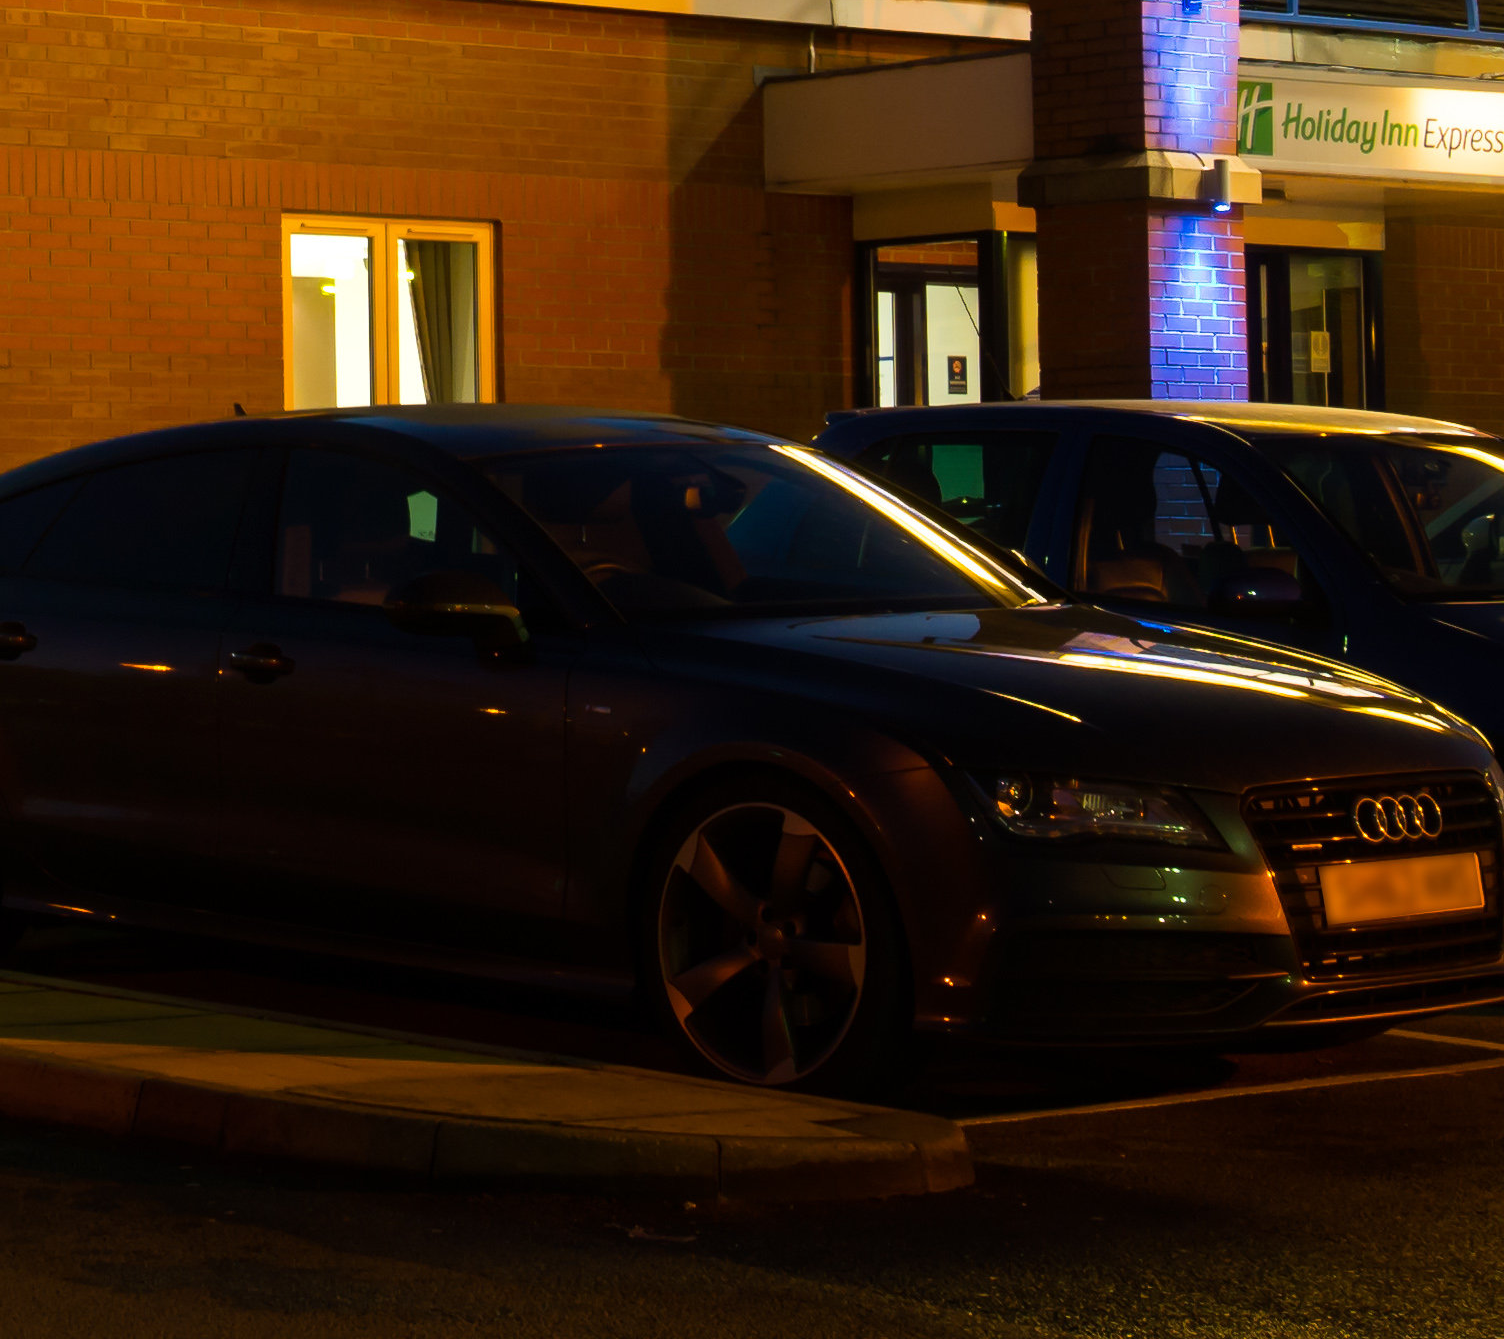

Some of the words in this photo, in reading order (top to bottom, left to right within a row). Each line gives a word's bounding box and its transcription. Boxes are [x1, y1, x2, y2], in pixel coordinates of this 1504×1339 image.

[1281, 102, 1377, 155] Holiday
[1380, 109, 1419, 148] Inn
[1423, 117, 1504, 159] Express
